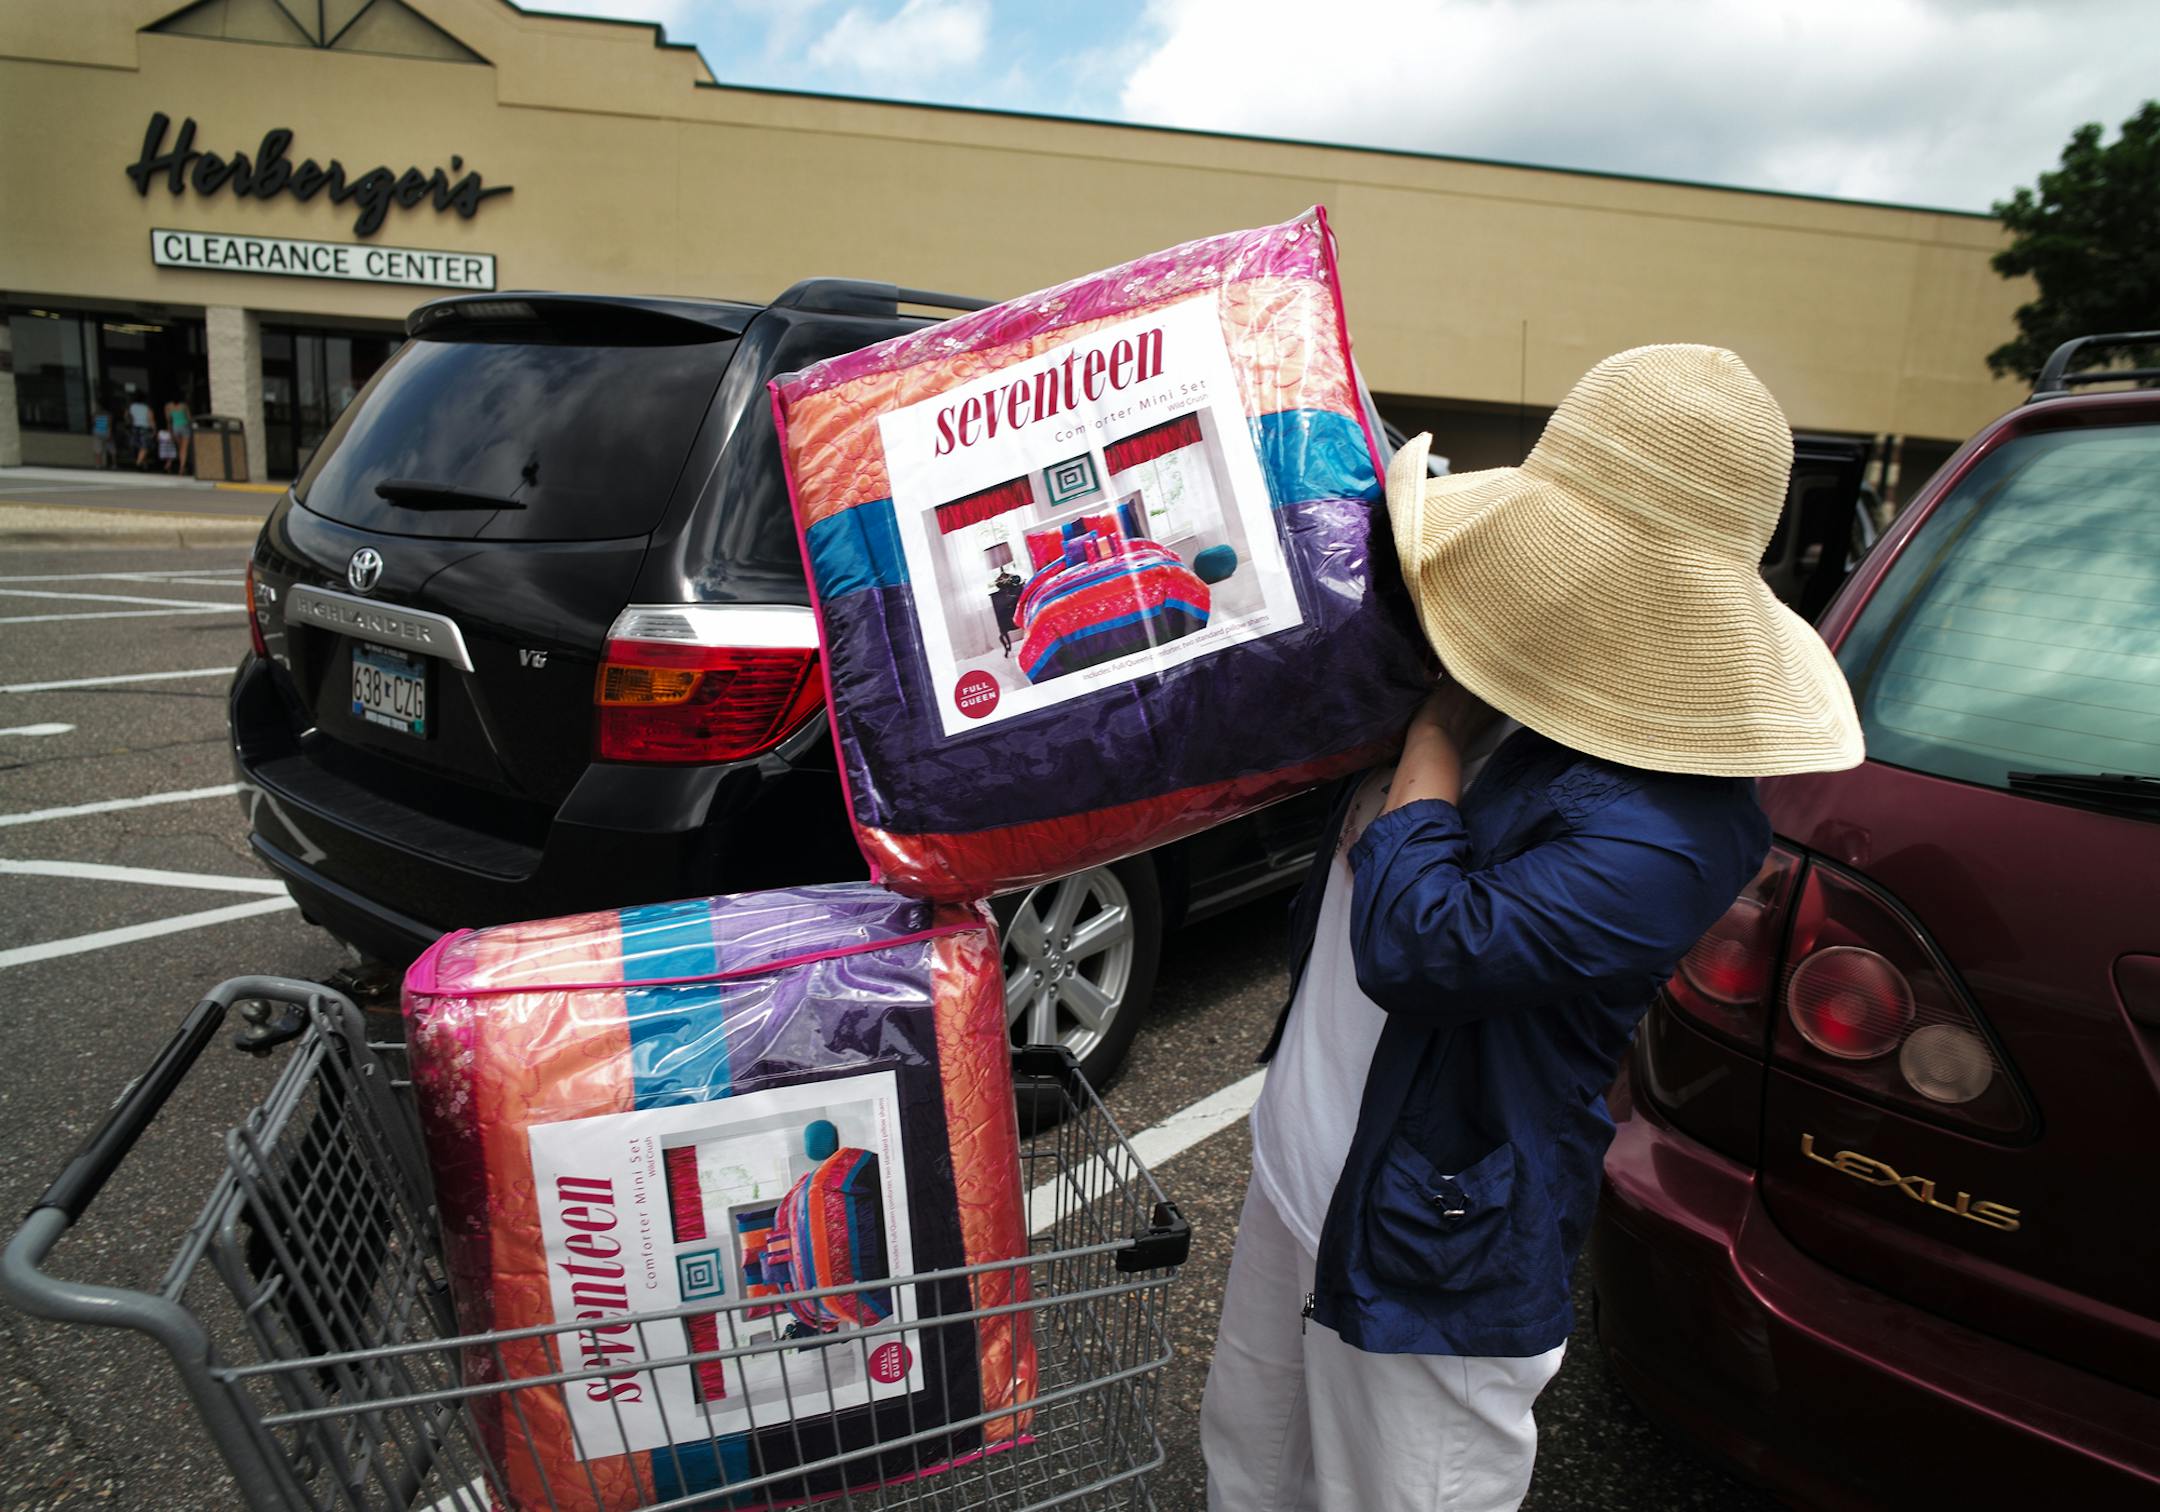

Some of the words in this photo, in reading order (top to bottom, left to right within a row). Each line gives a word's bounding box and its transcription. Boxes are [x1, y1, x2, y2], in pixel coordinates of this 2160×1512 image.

[127, 112, 513, 238] Herberger's
[163, 234, 351, 274] CLEARANCE
[365, 251, 484, 284] CENTER
[934, 327, 1165, 458] seventeen
[1167, 401, 1186, 412] Wild
[1054, 406, 1133, 443] Comorter
[1139, 389, 1173, 411] Mini
[1180, 380, 1206, 396] Set
[297, 598, 433, 643] HIGHLANDER
[519, 649, 549, 669] V6
[353, 667, 381, 707] 638
[394, 676, 423, 718] CZG
[961, 691, 996, 708] QUEEN
[962, 682, 989, 695] FULL
[629, 1138, 642, 1163] Set
[644, 1136, 655, 1158] Crush
[646, 1159, 656, 1178] Wild
[1801, 1133, 2021, 1231] LEXUS
[632, 1171, 647, 1204] Mini
[639, 1212, 658, 1290] Comforter
[555, 1175, 643, 1404] seventeen
[880, 1351, 889, 1376] FULL
[890, 1345, 900, 1378] QUEEN
